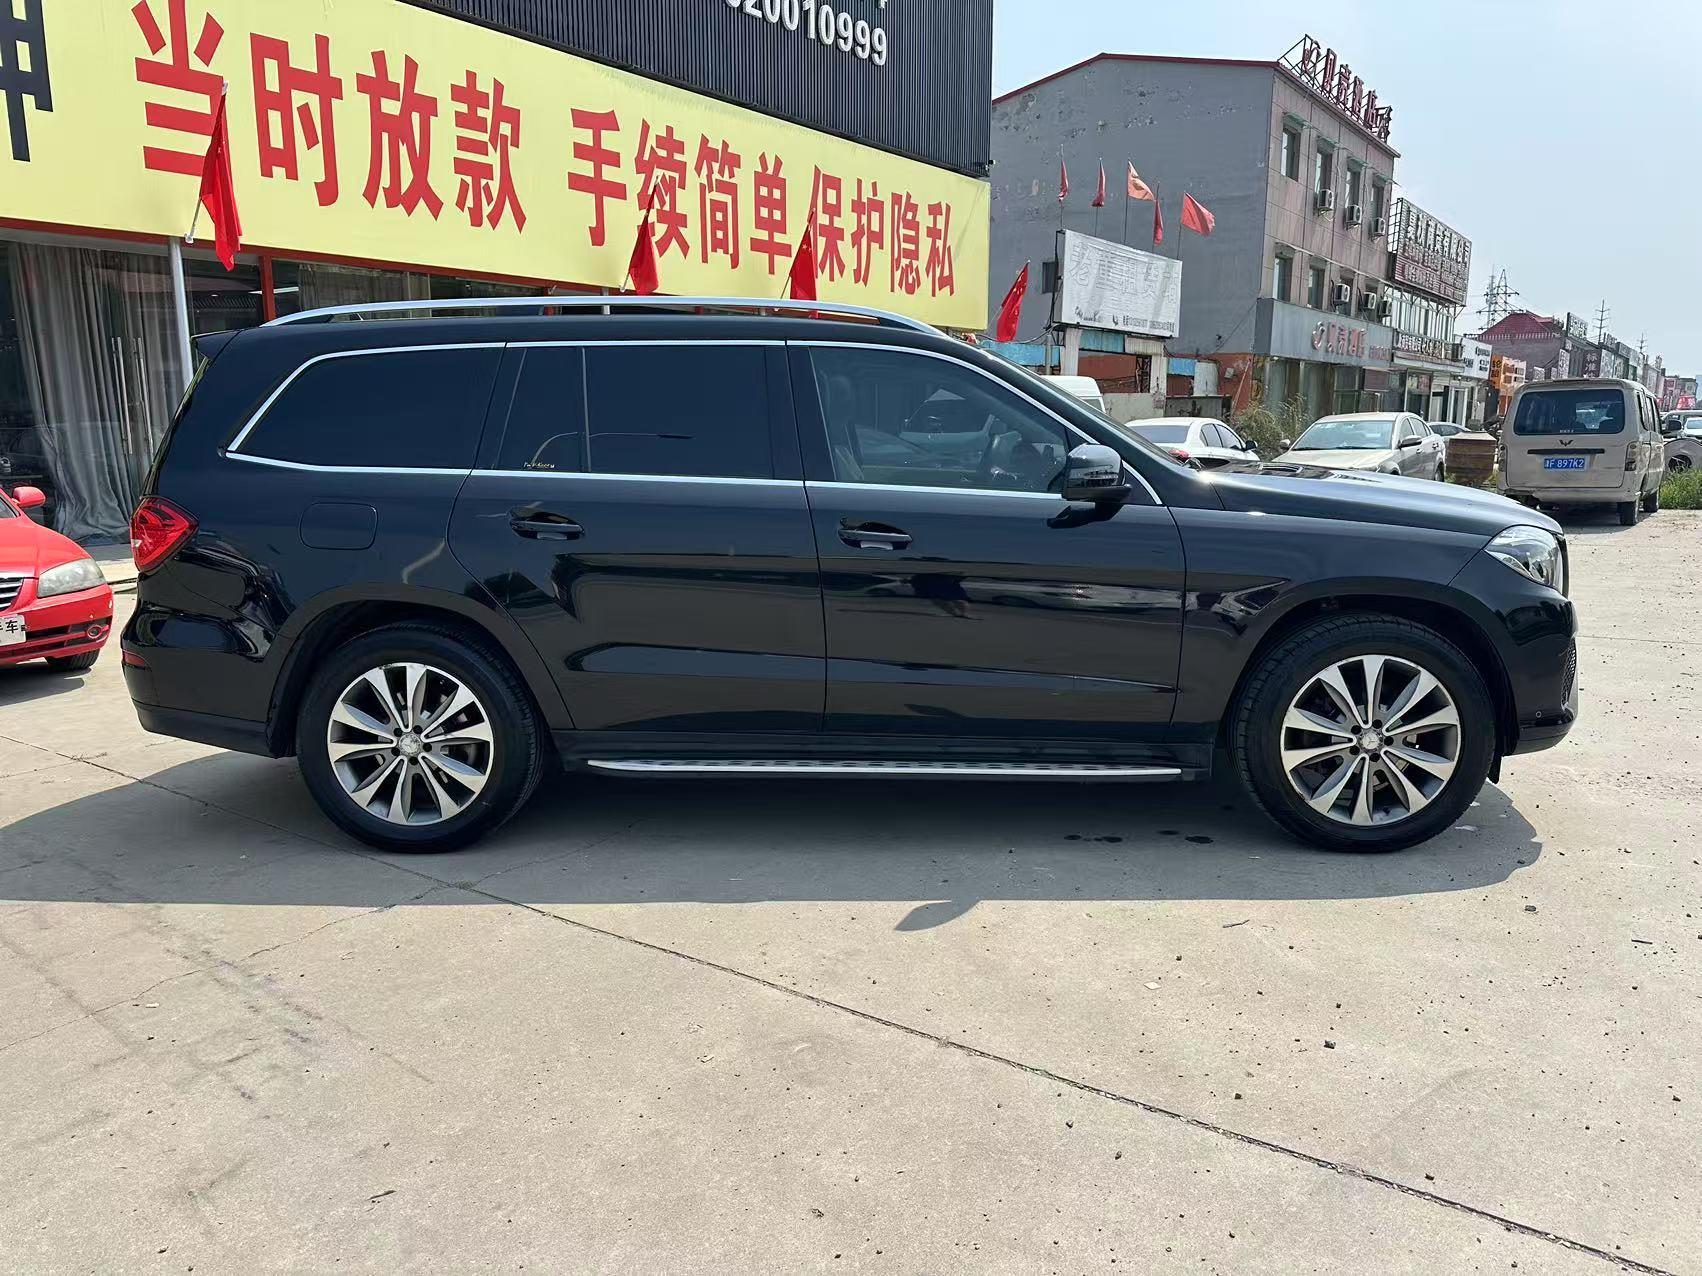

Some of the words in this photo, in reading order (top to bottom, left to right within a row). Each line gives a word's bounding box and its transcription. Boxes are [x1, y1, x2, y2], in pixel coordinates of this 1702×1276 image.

[725, 0, 887, 66] 0010999
[131, 0, 527, 234] 当时放款
[568, 108, 792, 275] 手续简单
[808, 164, 956, 298] 保护隐私
[0, 619, 18, 633] 车
